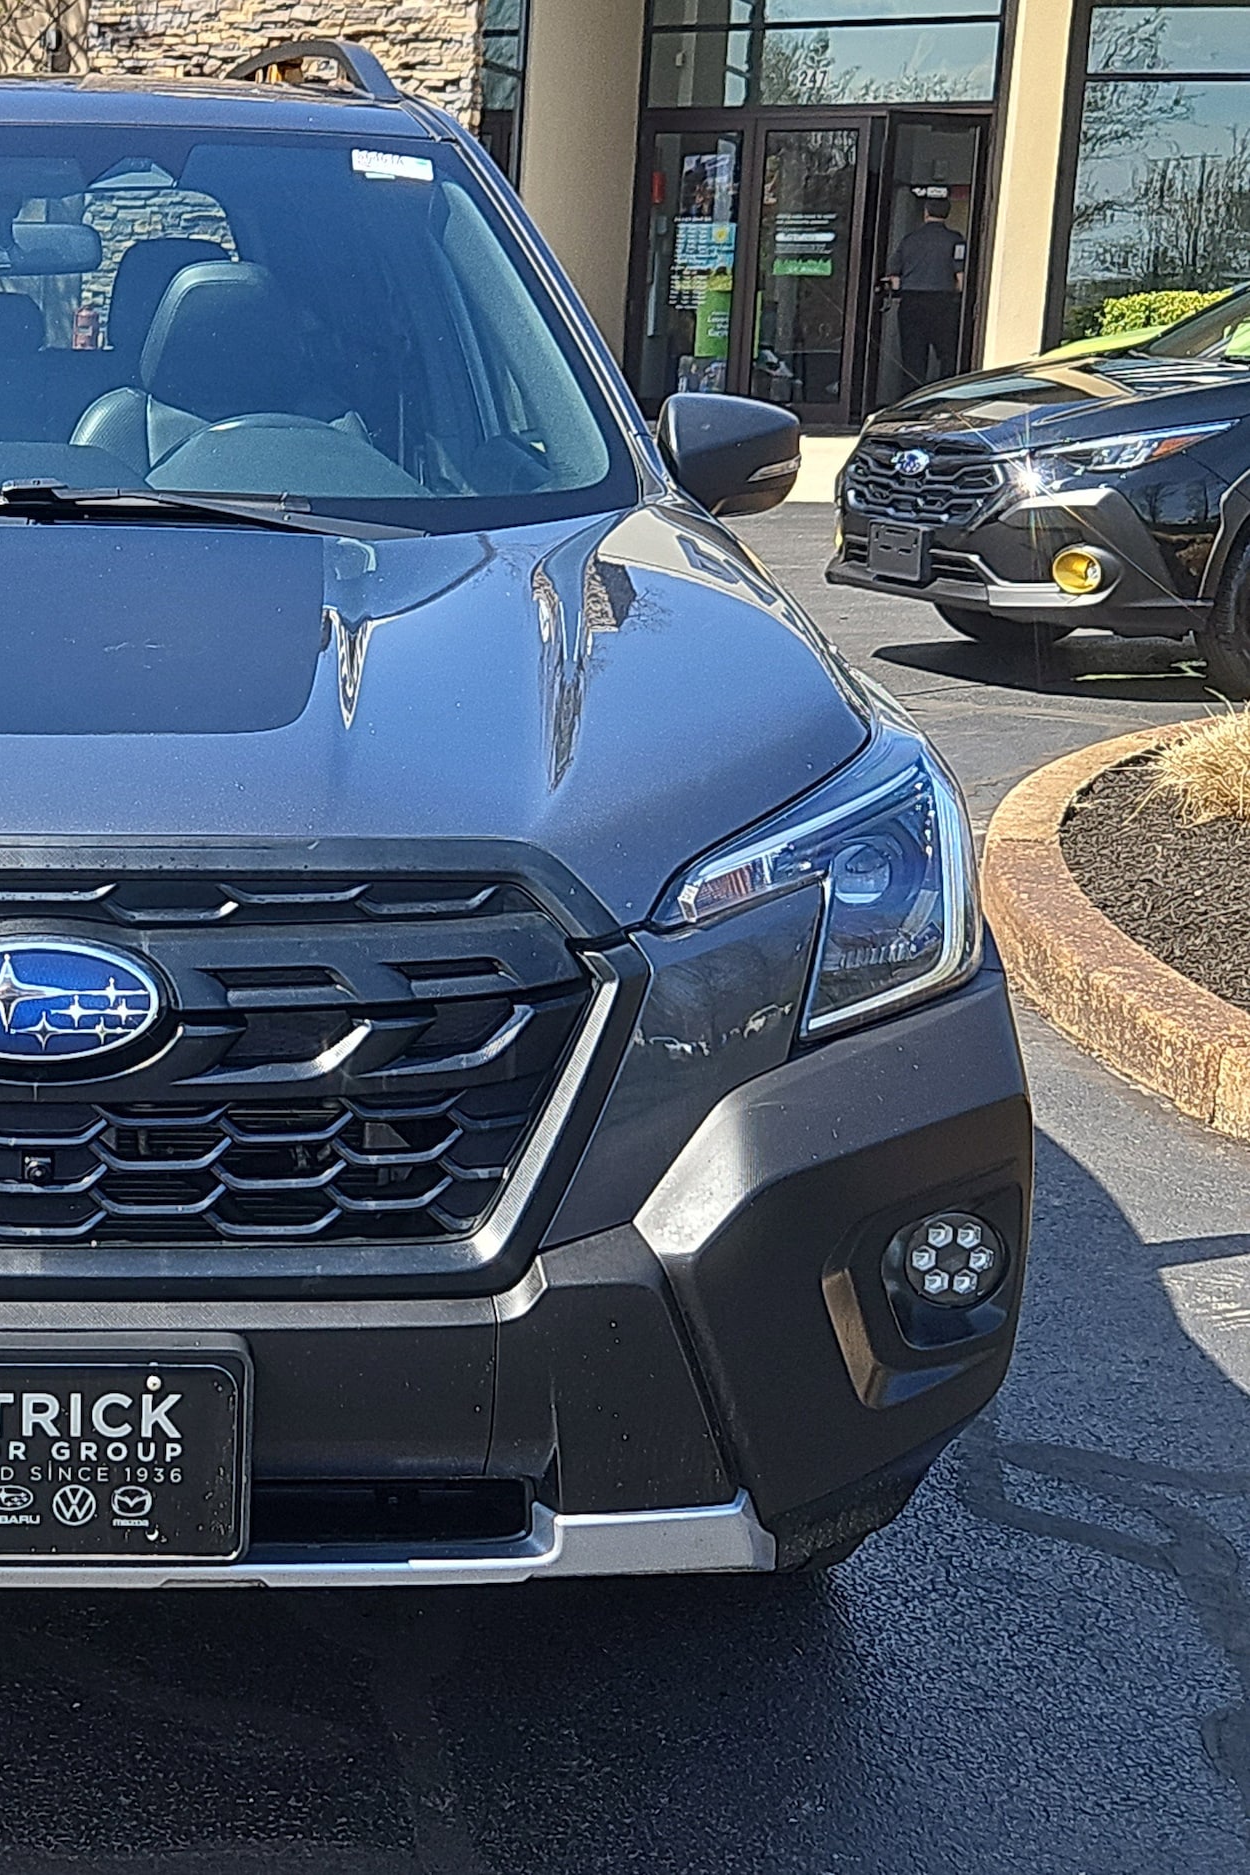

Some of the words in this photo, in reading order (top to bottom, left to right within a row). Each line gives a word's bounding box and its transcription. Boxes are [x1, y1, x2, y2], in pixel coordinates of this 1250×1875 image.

[798, 70, 828, 88] 247
[51, 1441, 183, 1462] GROUP
[30, 1466, 109, 1482] SINCE
[124, 1466, 183, 1483] 1936
